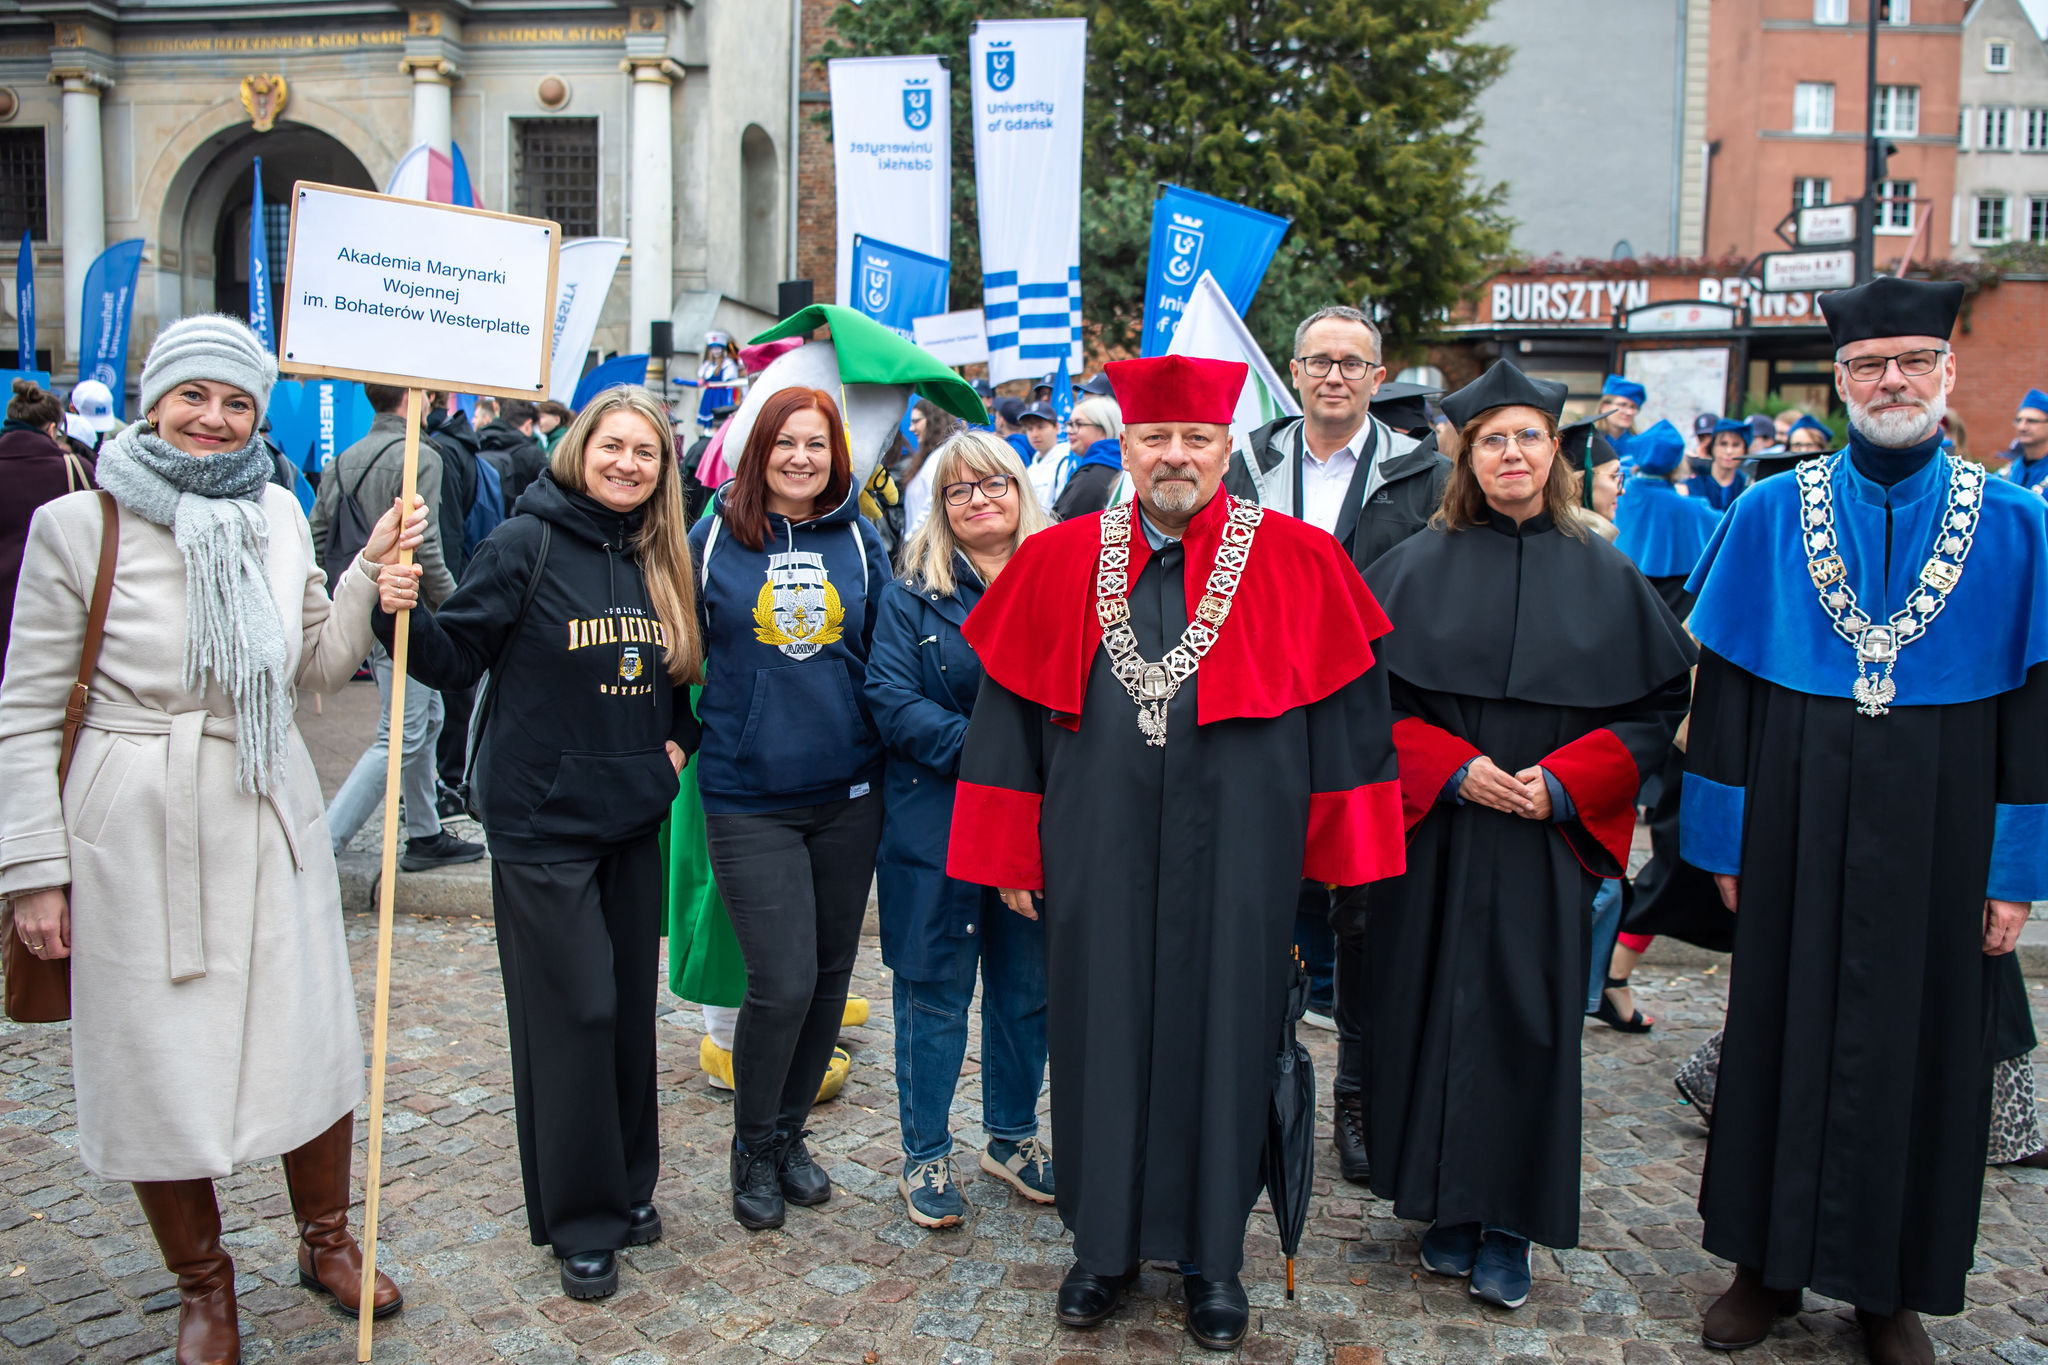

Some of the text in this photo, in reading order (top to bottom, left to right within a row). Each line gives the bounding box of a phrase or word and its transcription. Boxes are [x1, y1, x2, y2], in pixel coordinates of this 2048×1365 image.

[987, 100, 1054, 115] University
[988, 117, 1053, 132] of Gdańsk
[337, 247, 506, 284] Akademia Marynarki
[383, 277, 460, 305] Wojennej
[1491, 278, 1649, 321] BURSZTYN
[303, 291, 530, 336] im. Bohaterów Westerplatte
[568, 617, 618, 651] NAVAL
[785, 643, 817, 654] AMW
